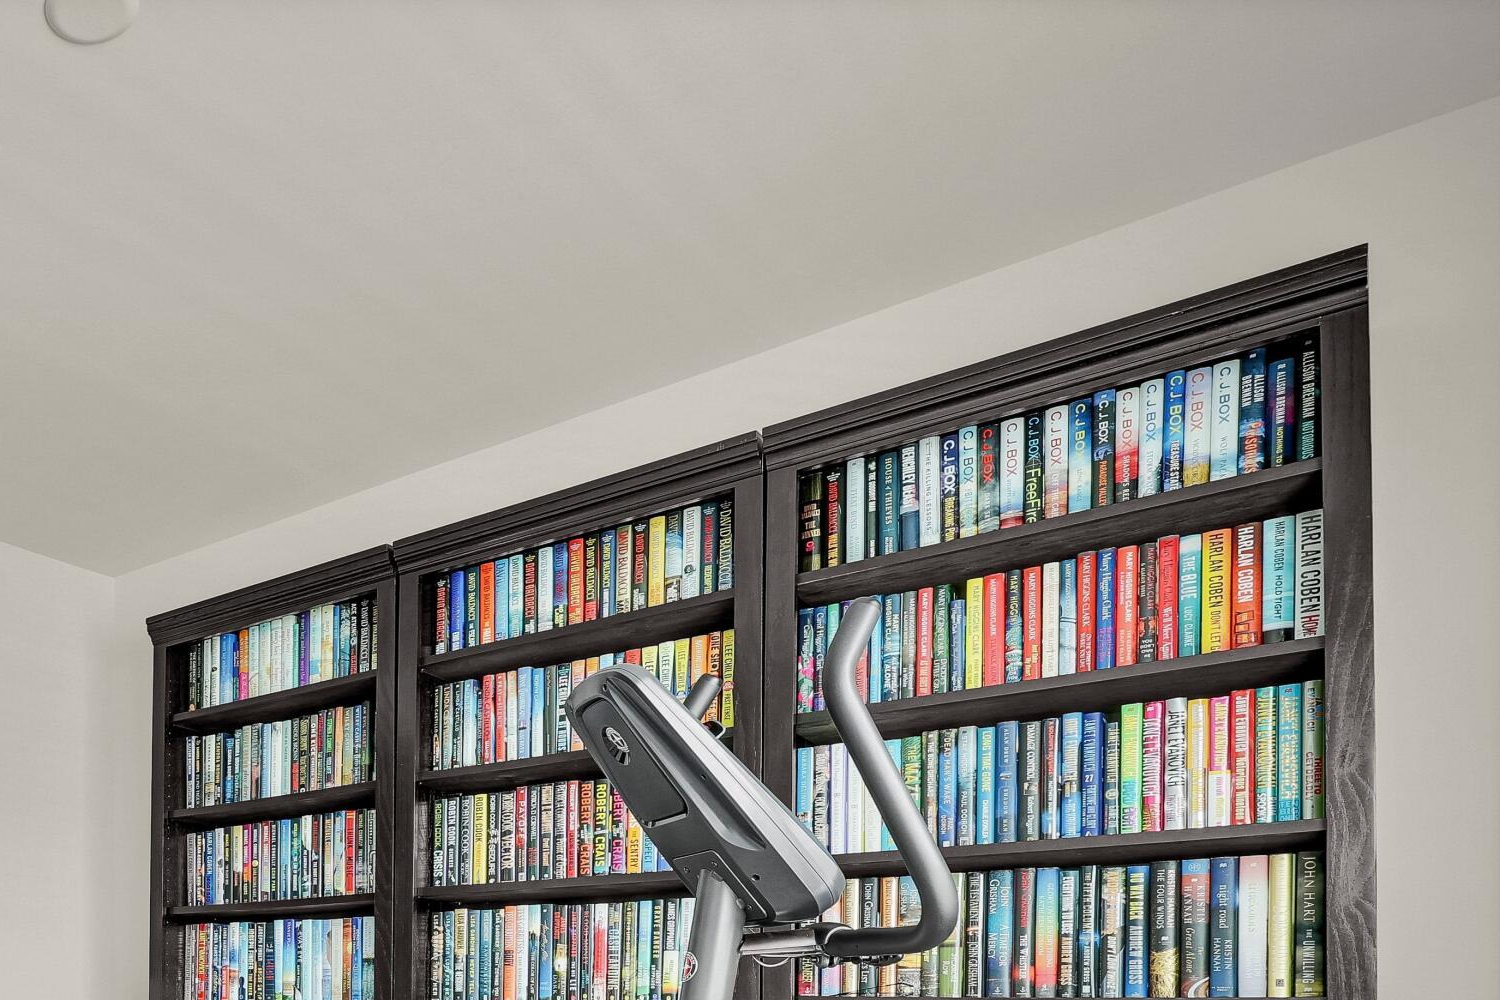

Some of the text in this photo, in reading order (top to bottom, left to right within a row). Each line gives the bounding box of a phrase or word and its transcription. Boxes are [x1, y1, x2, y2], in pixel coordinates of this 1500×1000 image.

[1276, 372, 1285, 395] ALLISON
[1169, 405, 1182, 434] BOX
[1219, 394, 1229, 425] BOX
[1276, 397, 1285, 424] BRENNAN
[1302, 351, 1314, 459] ALLISON BRENNAN NOTORIOUS
[1028, 440, 1039, 459] BOX
[1170, 440, 1179, 471] TREASURE
[718, 509, 733, 581] DAVID BALDACCI
[1274, 521, 1285, 547] HARLAN
[1300, 515, 1321, 567] HARLAN
[1125, 552, 1133, 571] MARY
[1183, 556, 1195, 572] THE
[1209, 533, 1224, 573] HARLAN
[1238, 526, 1254, 603] HARLAN COBEN
[1274, 549, 1284, 571] COBEN
[1125, 572, 1133, 599] HIGGINS
[1181, 574, 1197, 600] BLUE
[1209, 575, 1223, 608] COBEN
[1301, 570, 1321, 613] COBEN
[1274, 597, 1282, 620] TIGHT
[360, 606, 369, 661] DAVID BALDACCI
[724, 644, 732, 657] LEE
[724, 658, 732, 679] CHILD
[982, 732, 991, 792] LONG TIME GONE
[1168, 711, 1185, 787] JANET EVANOVICH
[434, 803, 442, 827] ROBIN
[595, 783, 607, 867] ROBERT CRAIS
[433, 850, 444, 878] CRISIS
[1303, 857, 1316, 888] JOHN
[1168, 869, 1176, 895] KRISTIN
[1156, 869, 1165, 929] THE FOUR WINDS
[1216, 885, 1228, 928] night road
[1303, 893, 1315, 923] HART
[1128, 873, 1143, 985] NO WAY BACK ANDREW GROSS
[607, 928, 620, 991] CASH LANDING
[1213, 938, 1221, 971] HANNAH
[1224, 939, 1232, 970] KRISTIN
[1302, 940, 1314, 984] UNWILLING
